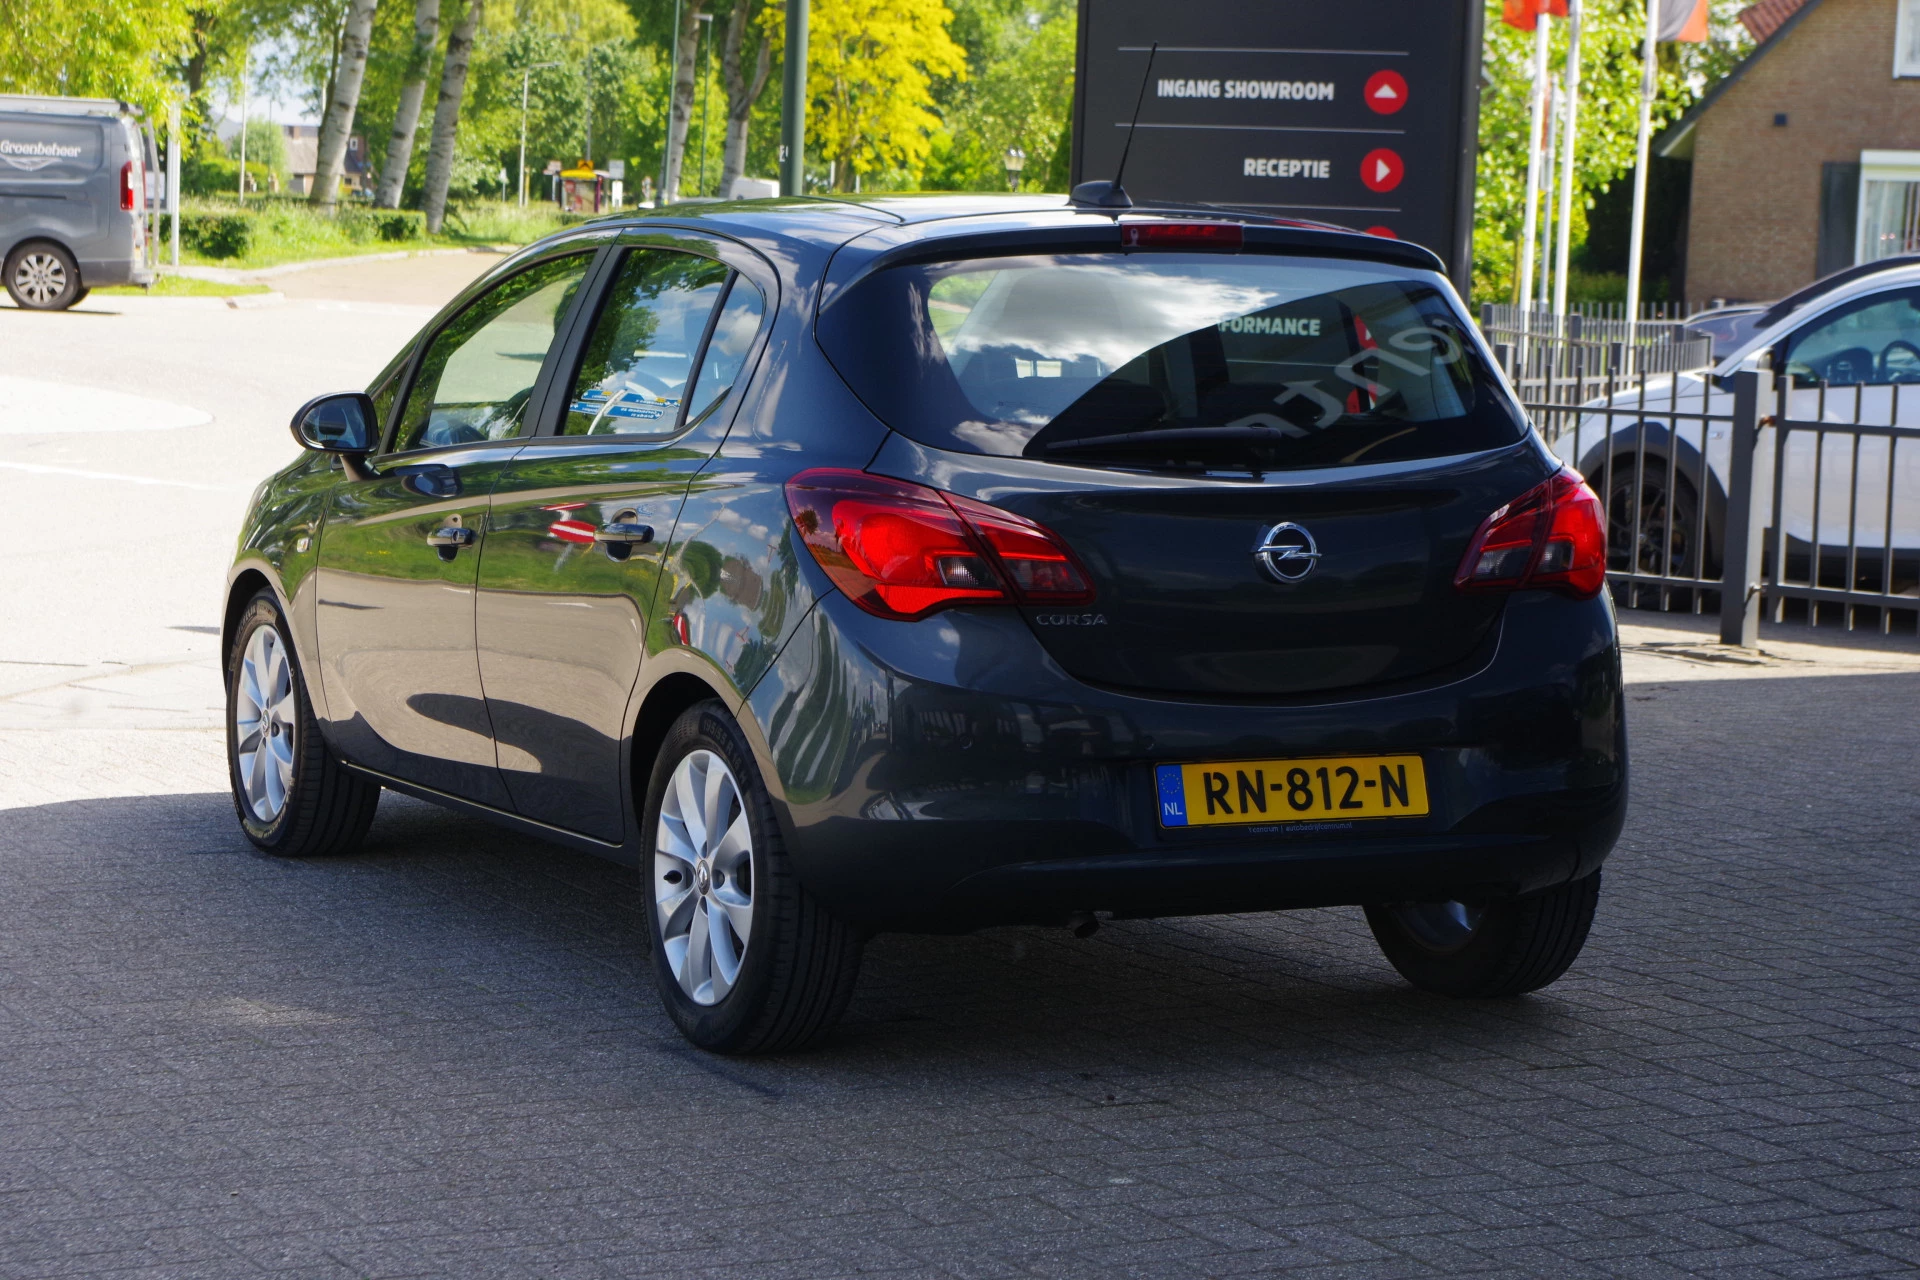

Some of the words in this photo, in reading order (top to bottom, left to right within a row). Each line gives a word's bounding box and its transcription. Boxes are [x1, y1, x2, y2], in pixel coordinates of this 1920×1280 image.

[1157, 78, 1221, 99] INGANG
[1224, 80, 1335, 102] SHOWROOM
[0, 139, 82, 158] Groenbeheer
[1243, 157, 1331, 179] RECEPTIE
[1218, 316, 1321, 337] FORMANCE
[1035, 613, 1109, 626] CORSA
[1203, 764, 1410, 816] RN-812-N
[1163, 801, 1184, 817] NL
